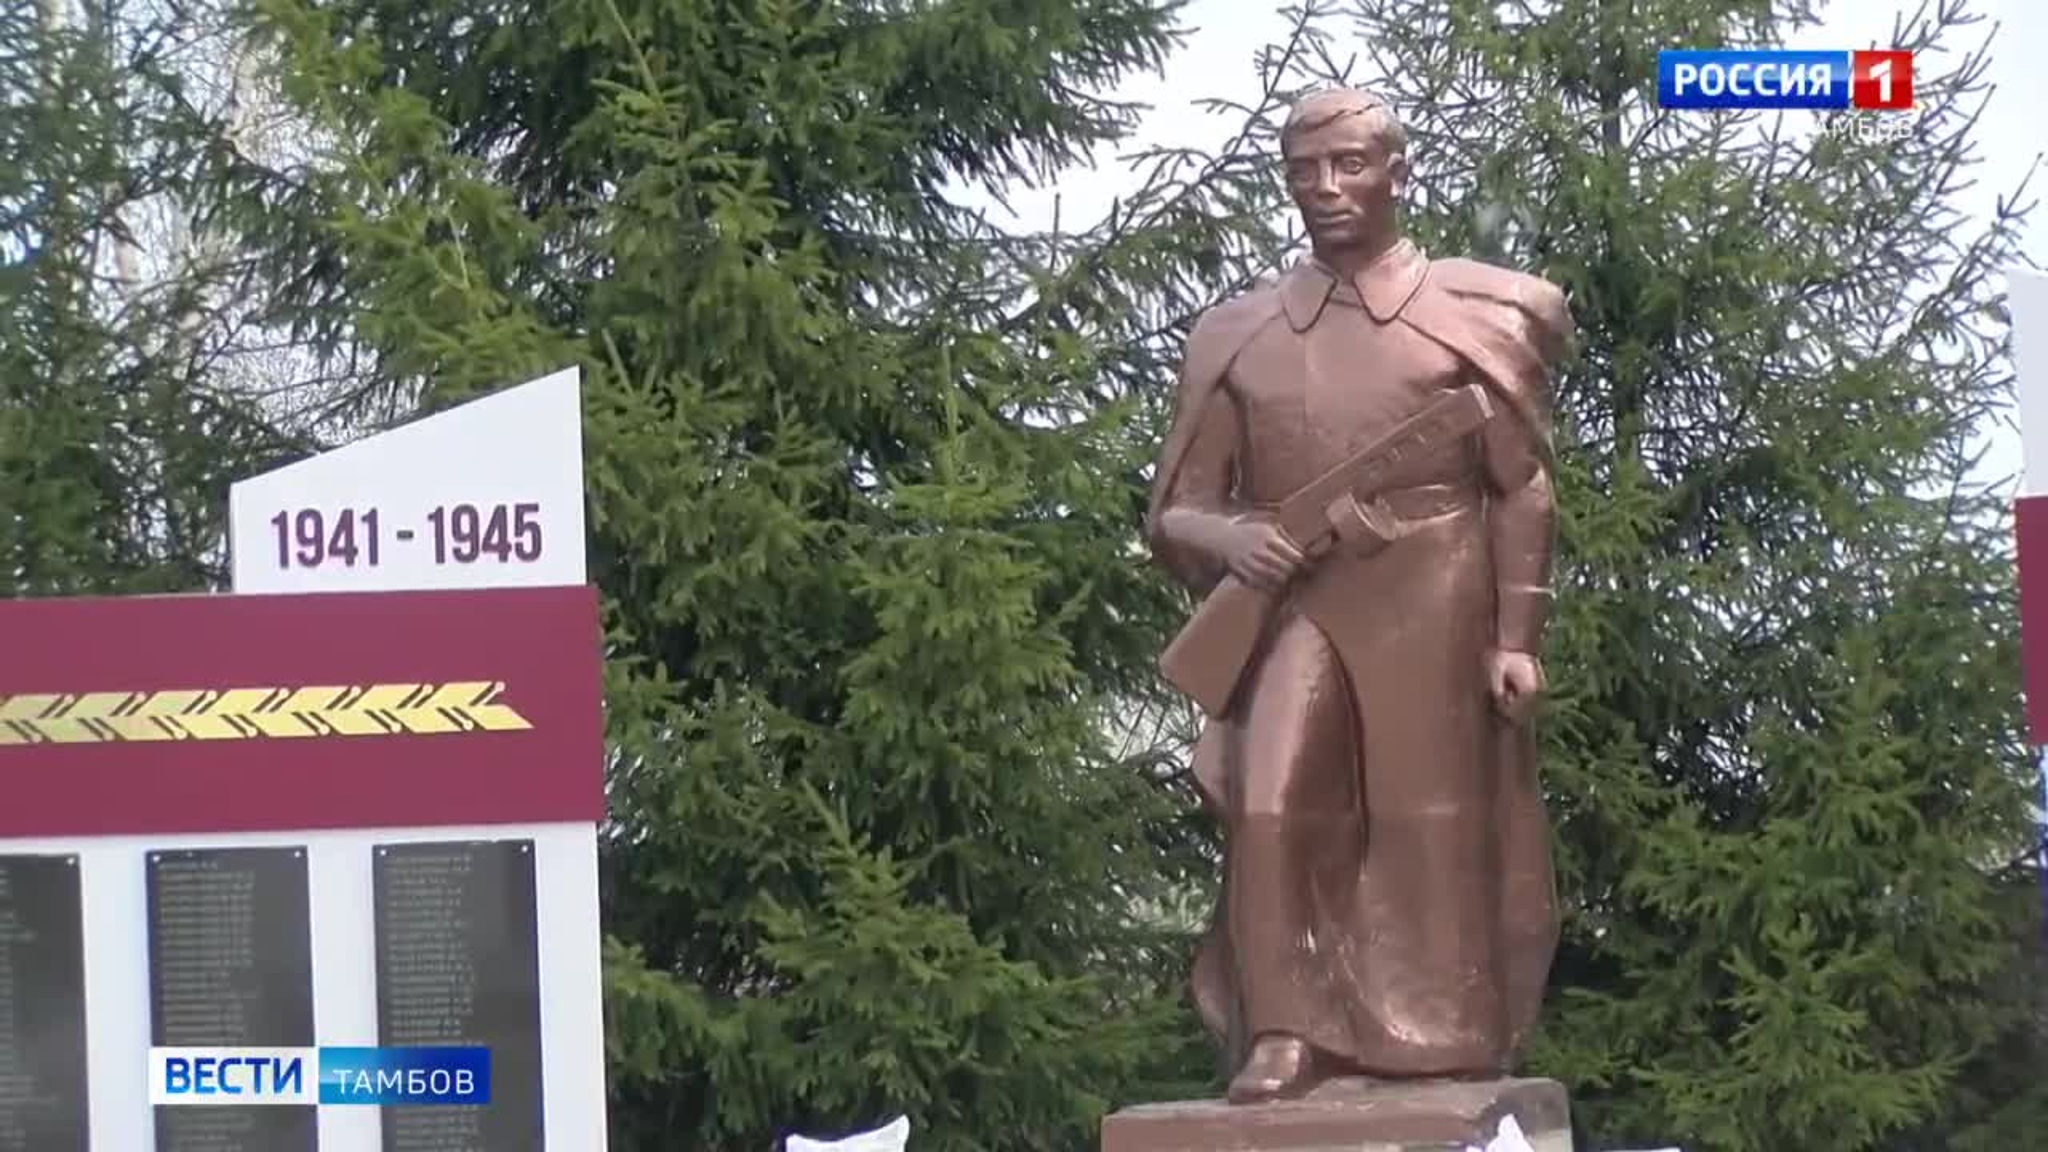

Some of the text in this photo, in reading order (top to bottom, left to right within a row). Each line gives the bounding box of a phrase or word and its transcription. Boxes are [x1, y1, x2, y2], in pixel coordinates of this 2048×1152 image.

[270, 503, 542, 569] 1941 - 1945
